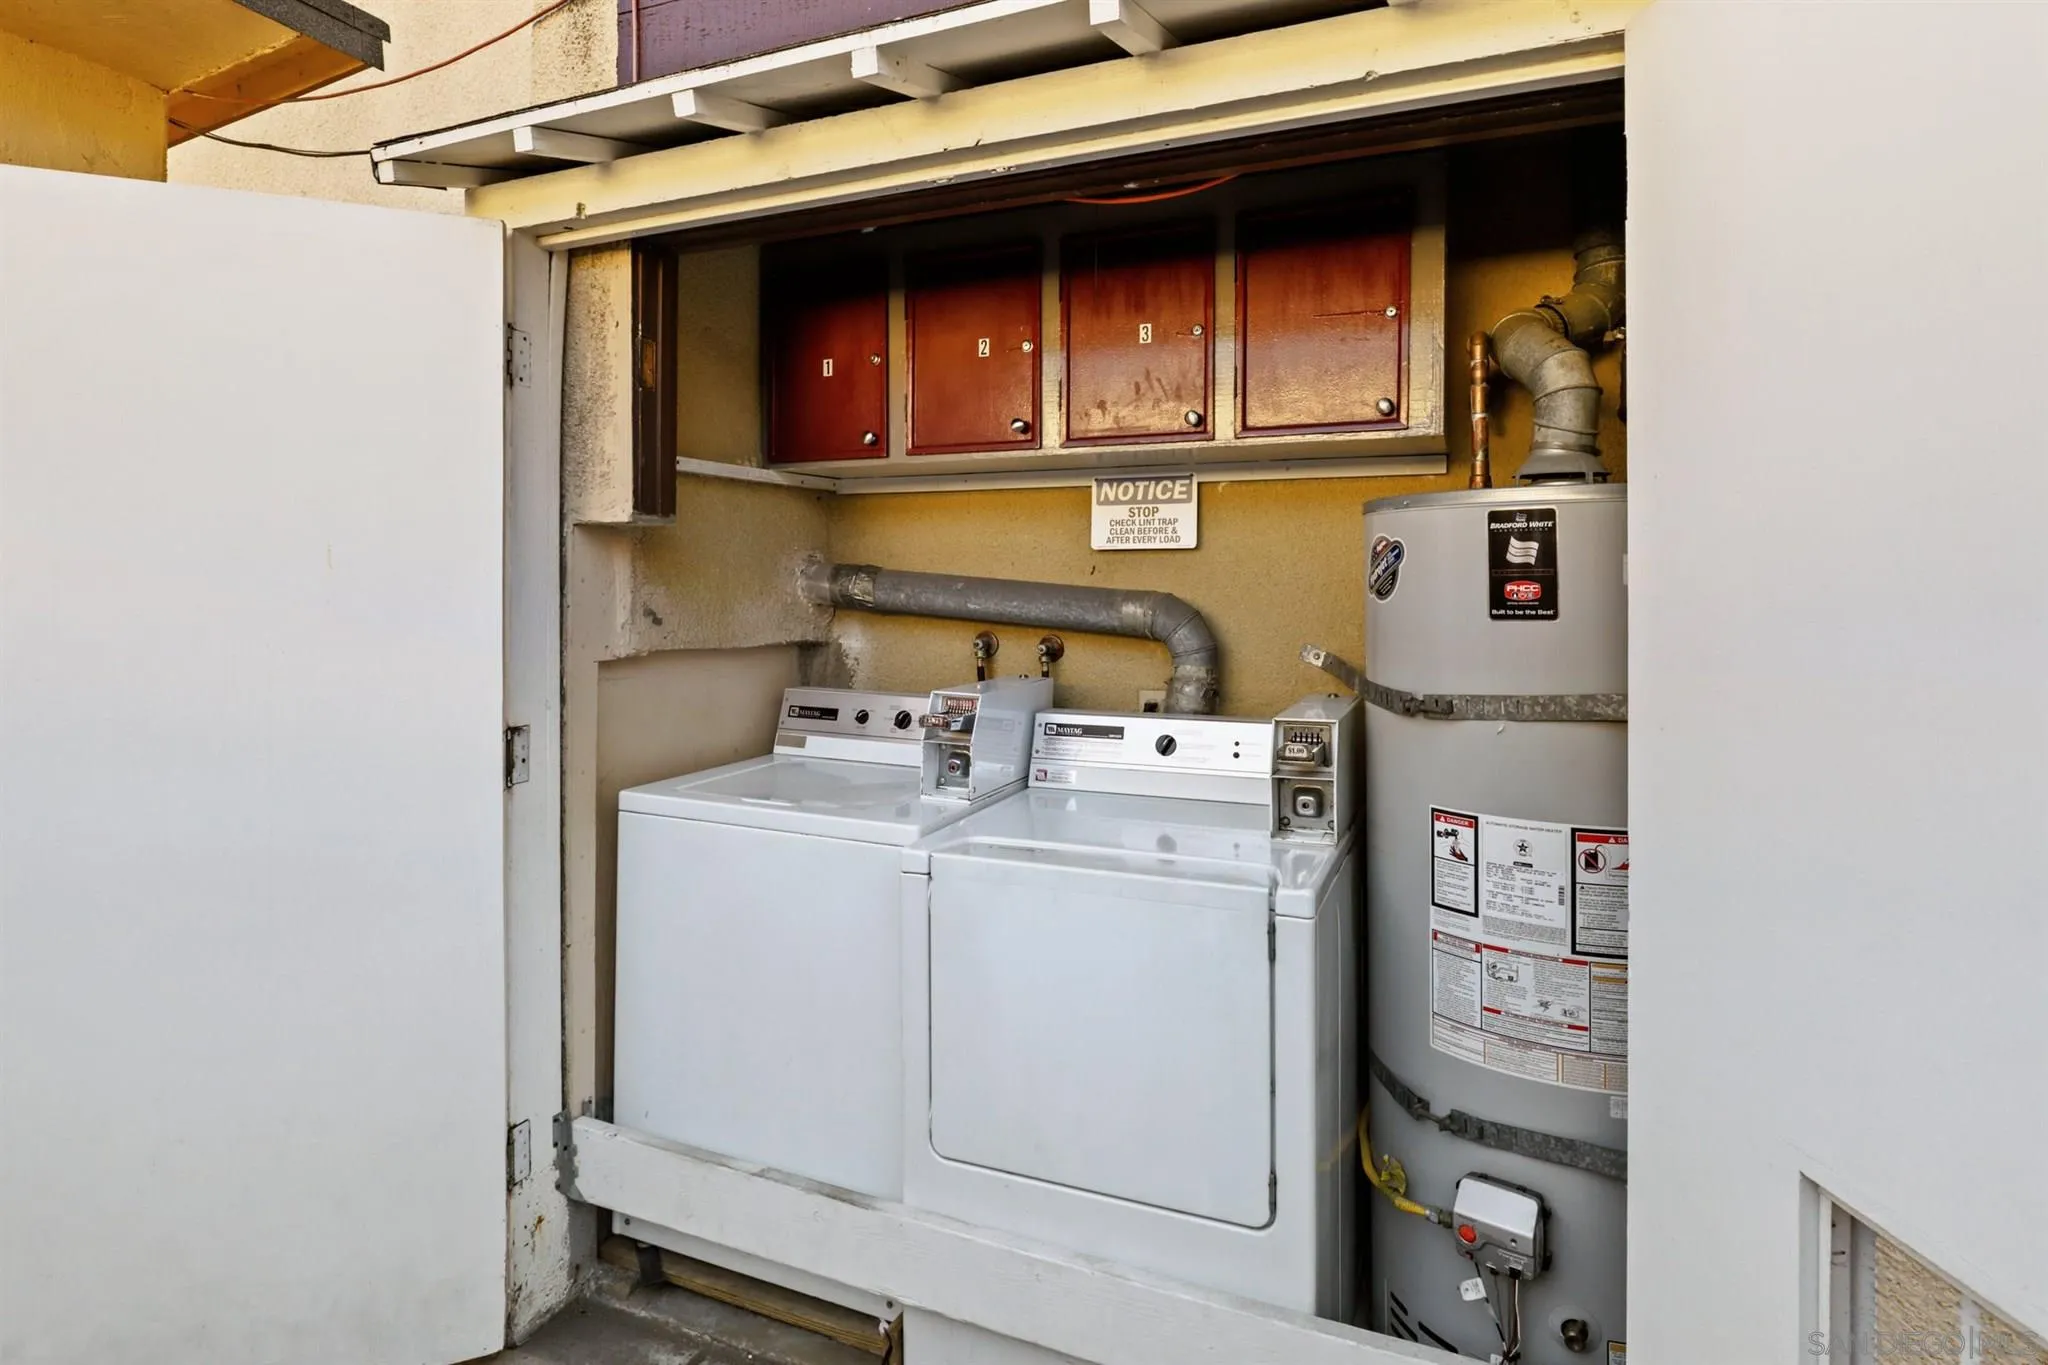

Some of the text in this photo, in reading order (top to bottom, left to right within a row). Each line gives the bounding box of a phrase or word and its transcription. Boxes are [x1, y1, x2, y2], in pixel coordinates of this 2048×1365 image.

[1142, 326, 1149, 341] 3
[981, 340, 987, 355] 2
[1100, 480, 1190, 502] NOTICE
[1128, 506, 1159, 518] STOP
[1109, 518, 1178, 527] CHECK LINT TRAP
[1490, 521, 1528, 530] BRADFORD
[1528, 520, 1553, 528] WHITE
[1109, 526, 1178, 536] CLEAN BEFORE &
[1106, 535, 1181, 544] AFTER EVERY LOAD
[1506, 584, 1539, 592] PHCC
[1057, 727, 1083, 735] MAYTAG
